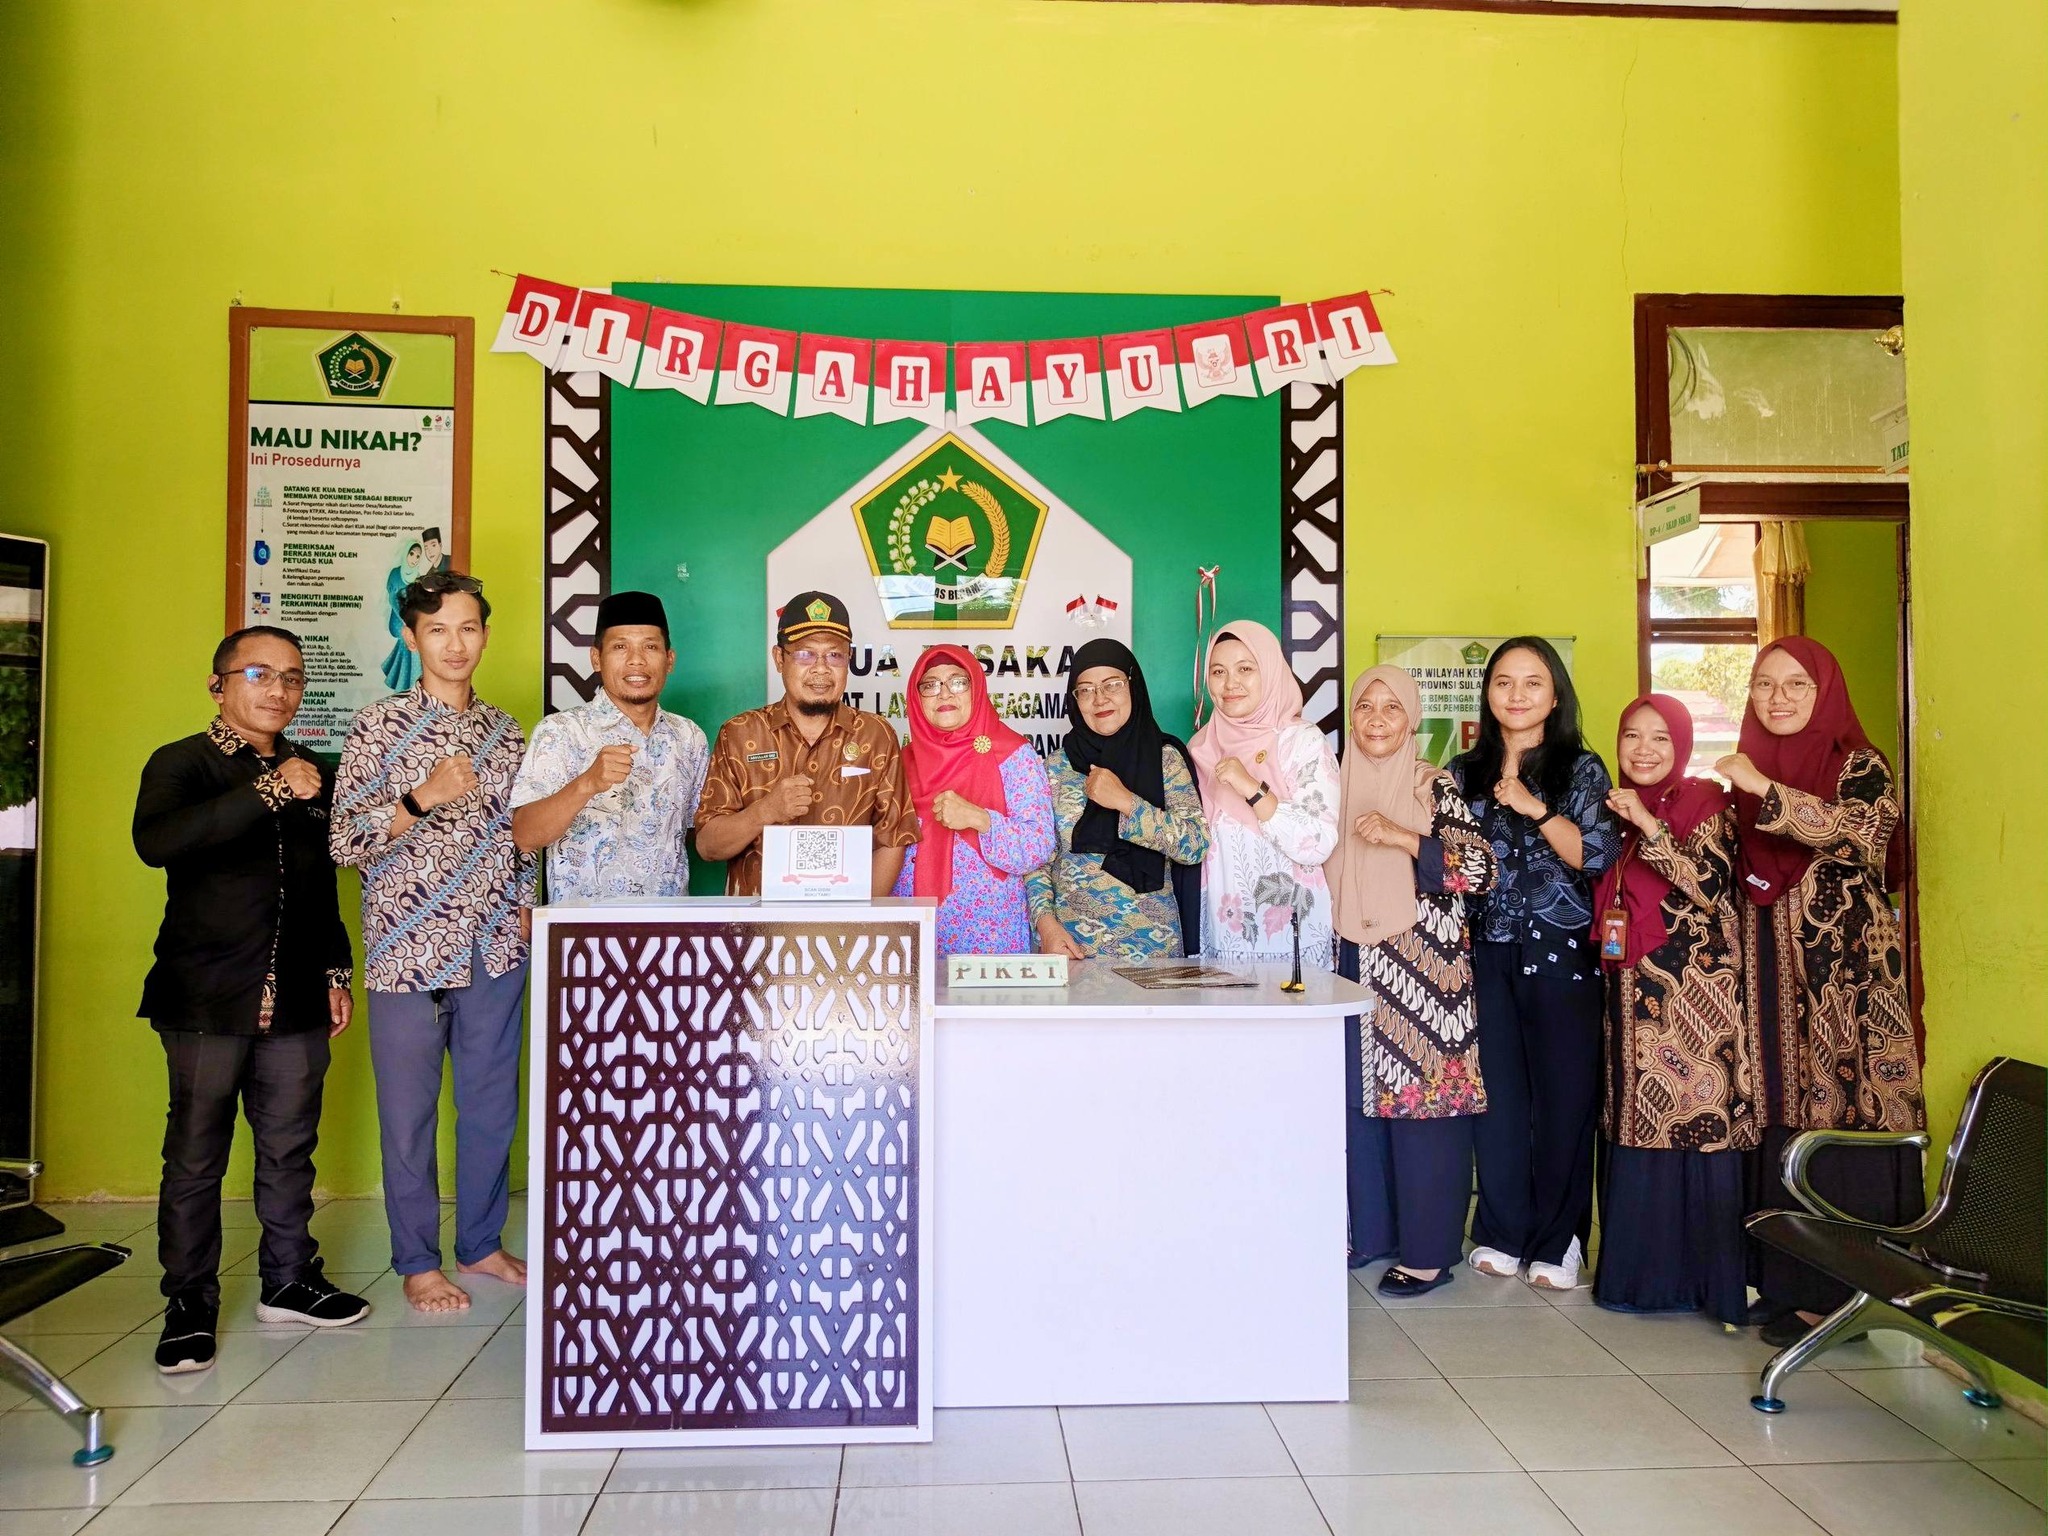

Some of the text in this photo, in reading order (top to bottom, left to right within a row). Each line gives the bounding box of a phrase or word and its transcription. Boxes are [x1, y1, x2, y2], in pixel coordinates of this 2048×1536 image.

[519, 299, 1362, 402] DIRGAHAYU RI
[251, 427, 422, 452] MAU NIKAH?
[251, 453, 361, 471] Ini Prosedurnya
[848, 643, 901, 677] UA
[1425, 668, 1465, 678] WILAYAH
[1417, 681, 1457, 689] ROVINSI
[1421, 704, 1480, 712] EKSI PEMBERD
[300, 719, 336, 727] mendaftar
[297, 728, 328, 737] PUSAKA.
[300, 739, 332, 747] appstore
[956, 961, 1059, 980] PIKET
